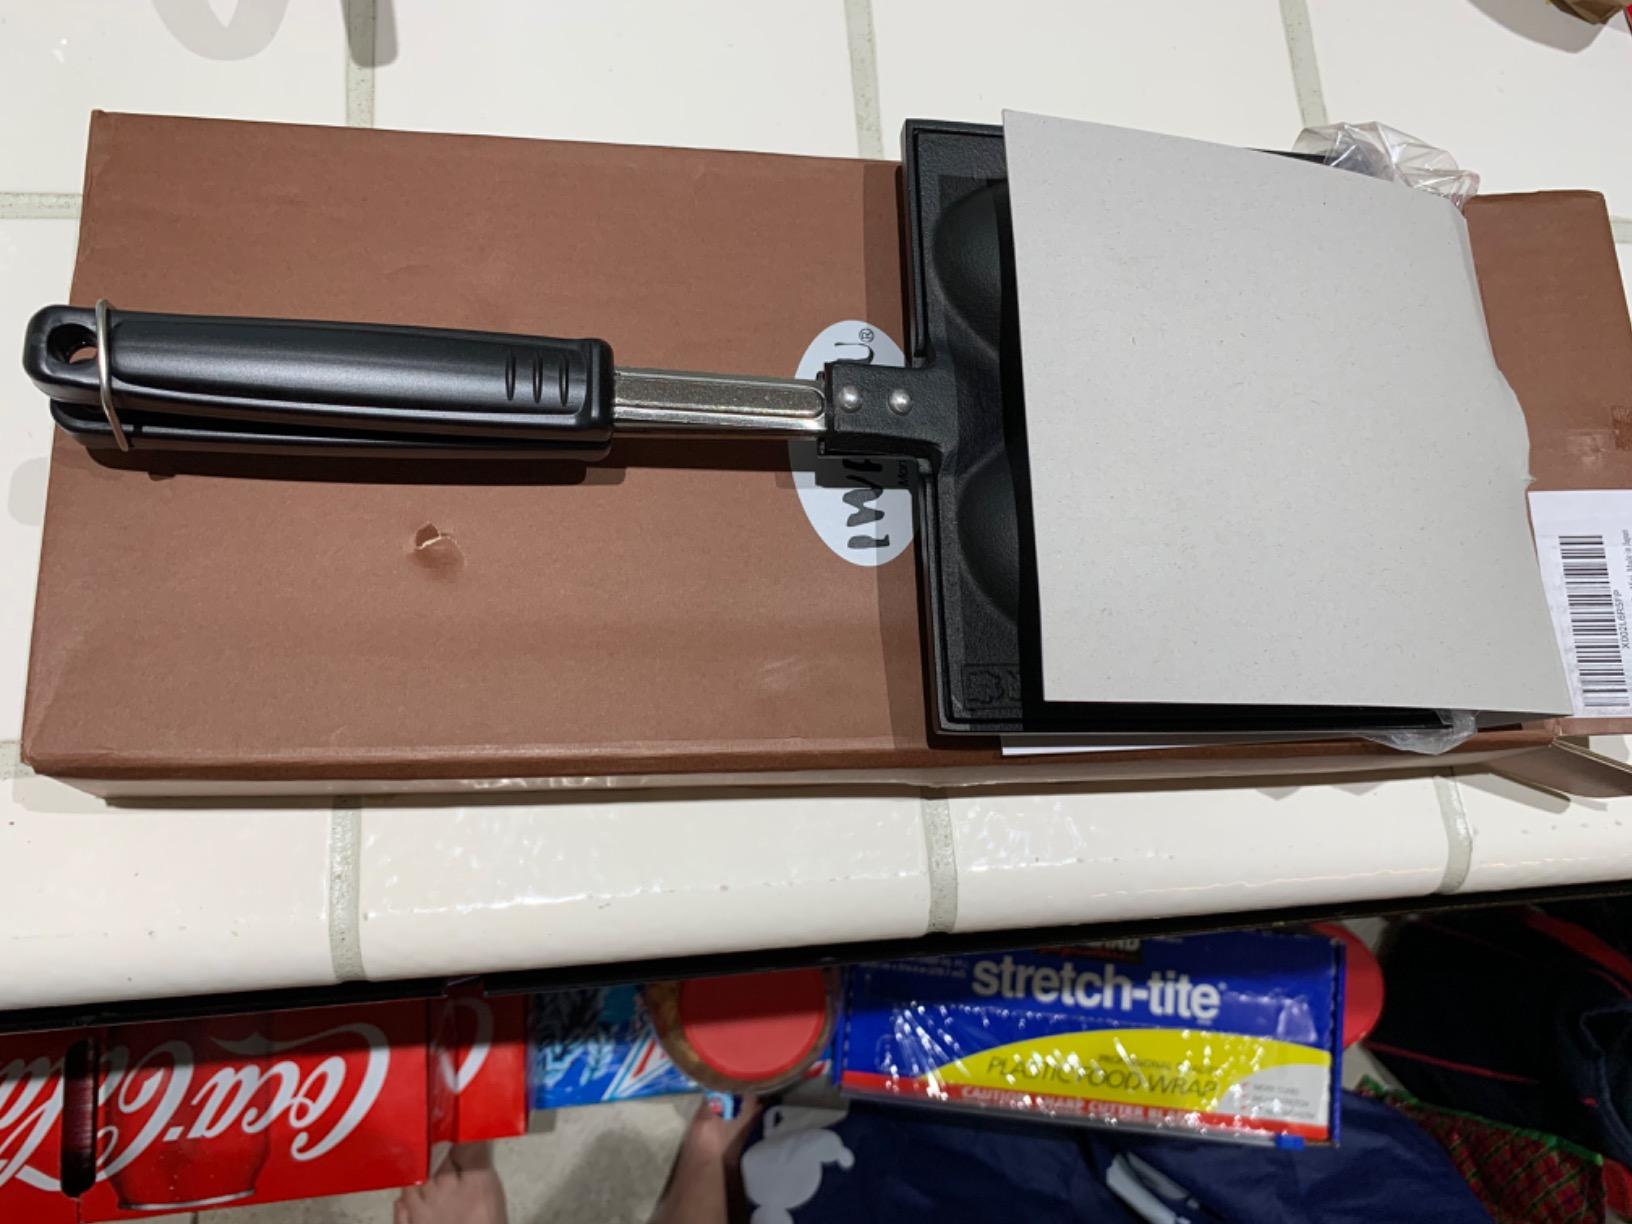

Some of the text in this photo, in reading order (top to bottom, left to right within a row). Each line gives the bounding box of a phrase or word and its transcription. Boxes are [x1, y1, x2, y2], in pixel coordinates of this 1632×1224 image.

[972, 955, 1220, 1020] stretch-tite
[1148, 1074, 1219, 1098] WRAP
[1031, 1095, 1085, 1113] HARP
